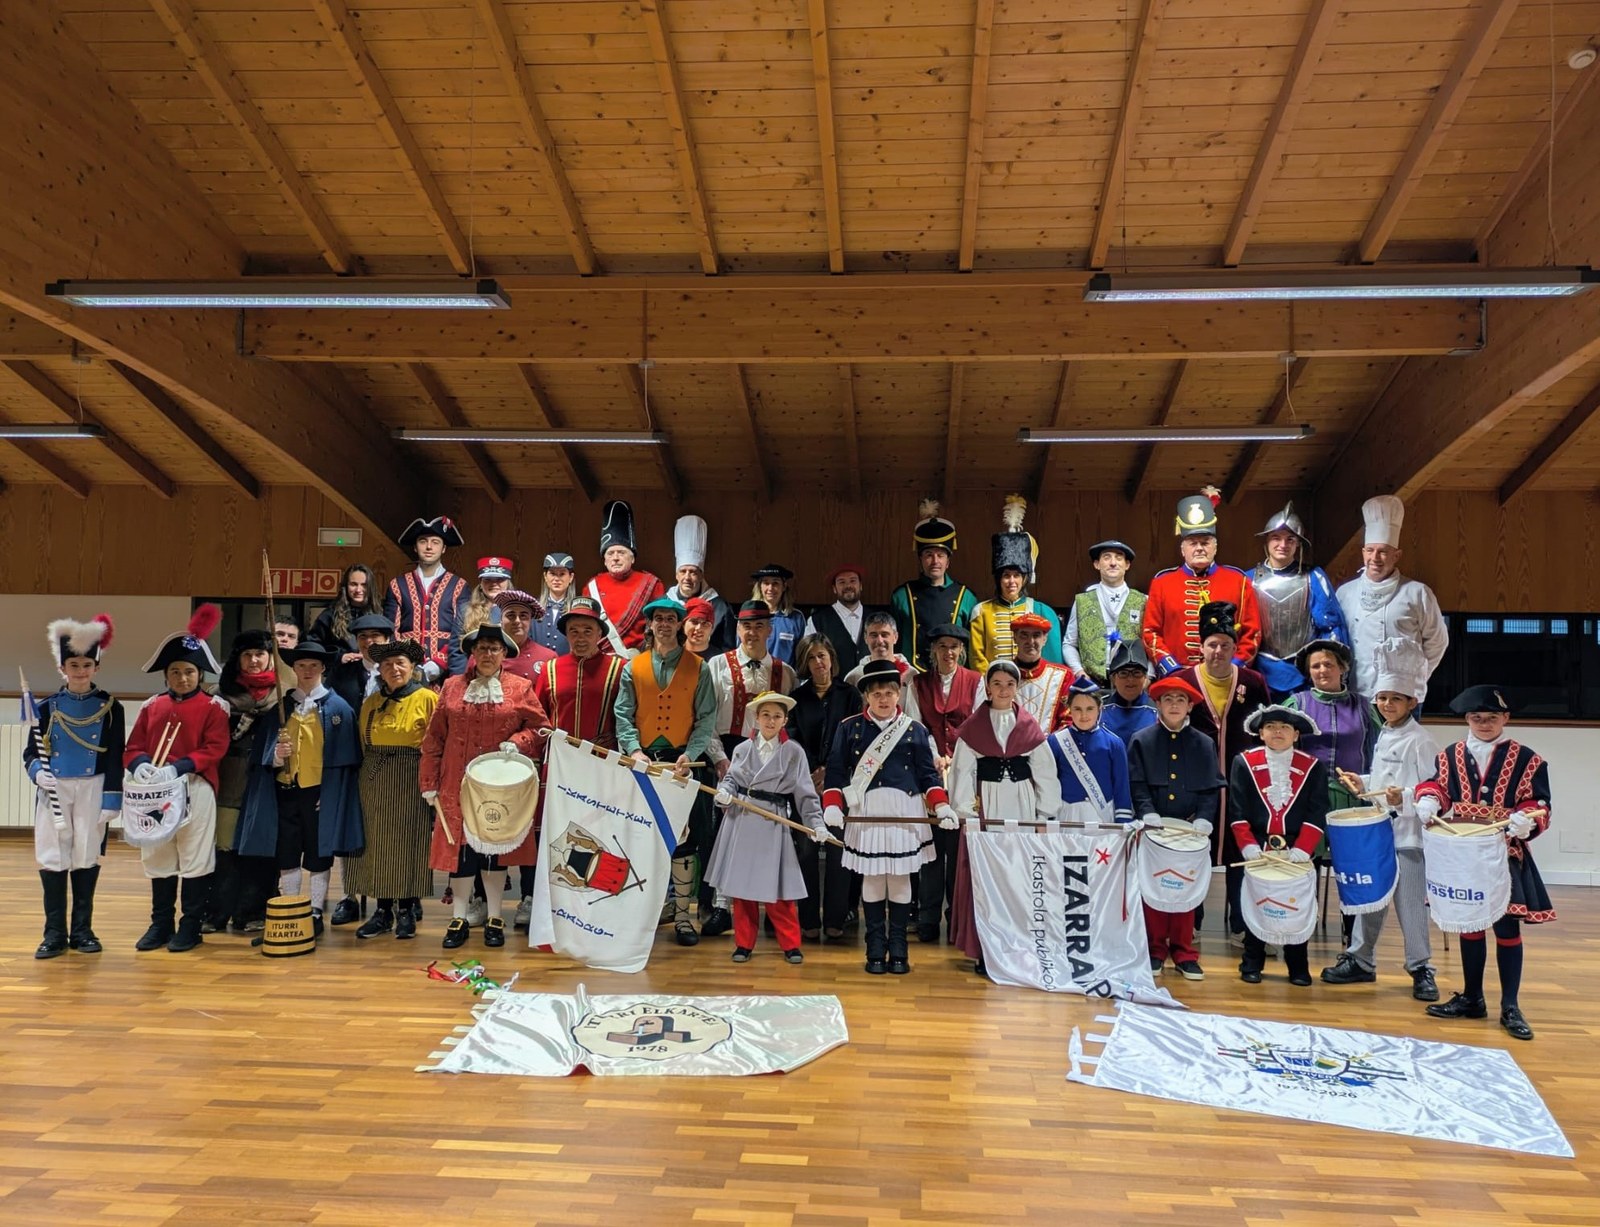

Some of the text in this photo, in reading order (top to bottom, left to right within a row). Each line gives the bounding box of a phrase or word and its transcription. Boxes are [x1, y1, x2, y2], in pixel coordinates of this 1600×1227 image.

[557, 784, 653, 829] IKASTETXEA
[1032, 855, 1048, 922] Ikastola
[272, 922, 299, 930] ITURRI
[266, 930, 304, 938] ELKARTEA
[627, 1044, 669, 1053] 1978
